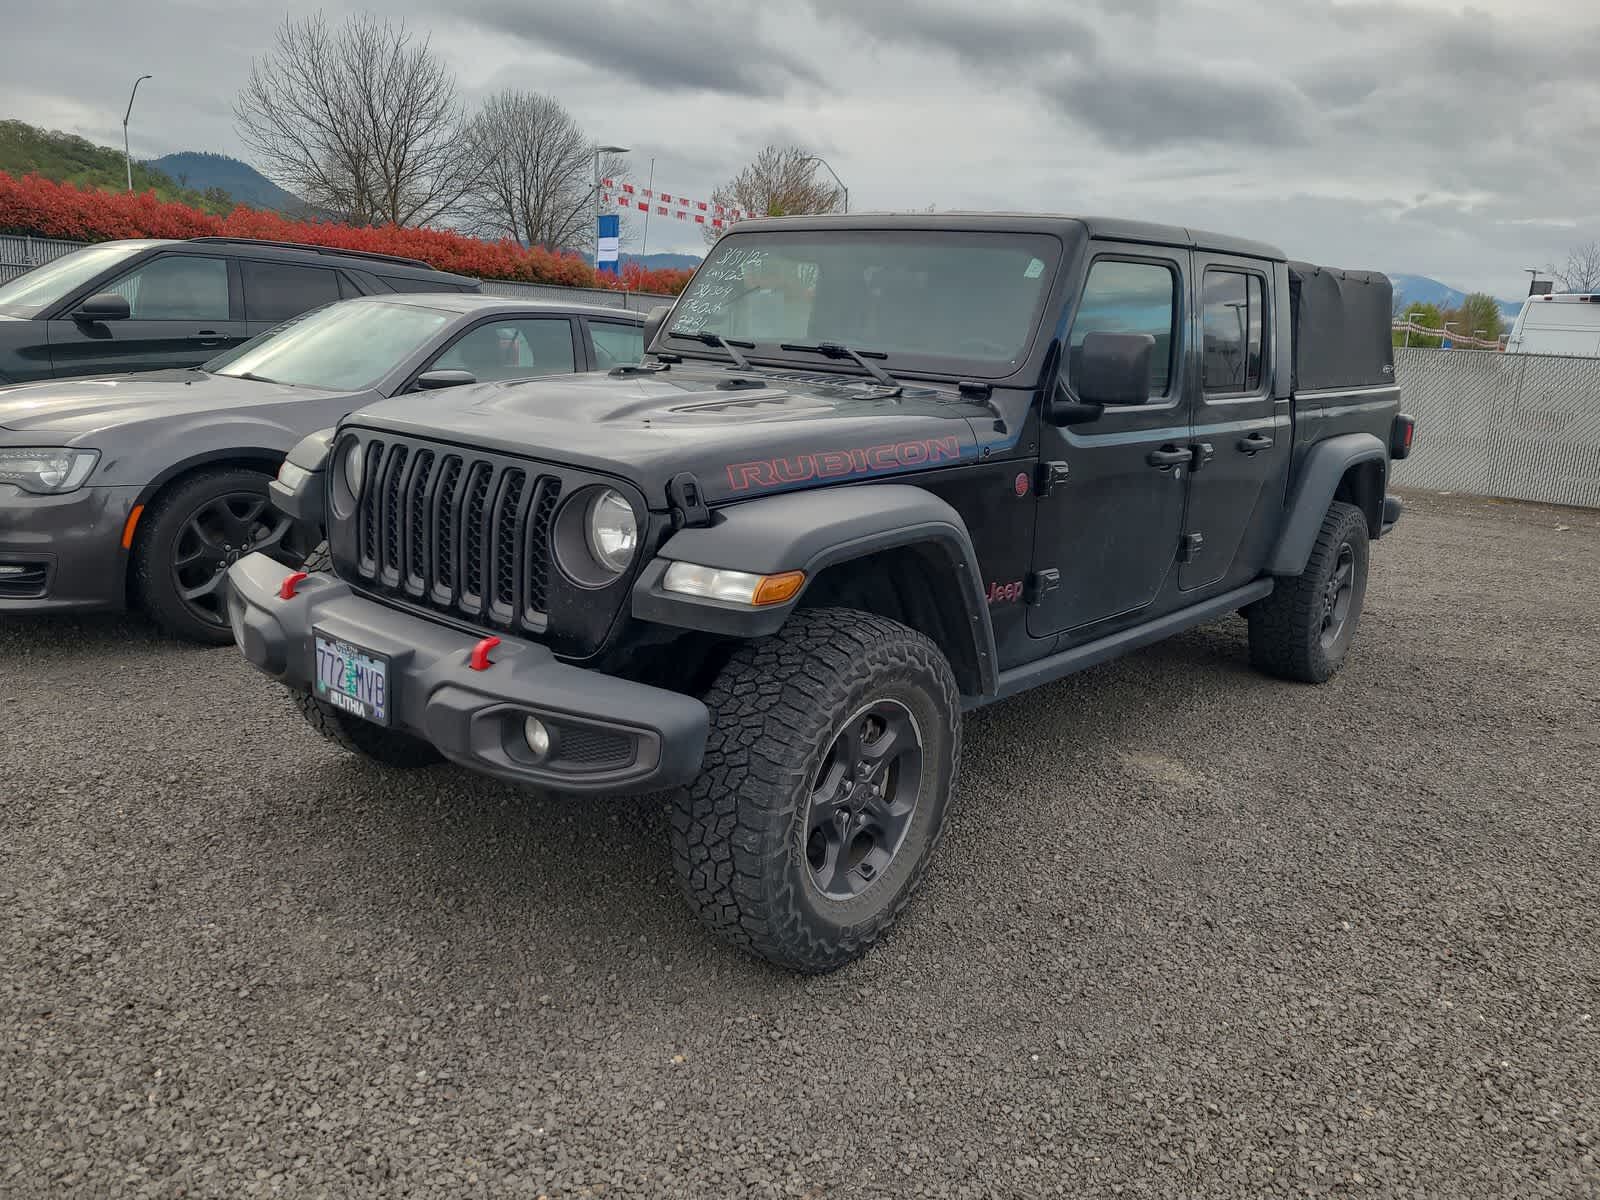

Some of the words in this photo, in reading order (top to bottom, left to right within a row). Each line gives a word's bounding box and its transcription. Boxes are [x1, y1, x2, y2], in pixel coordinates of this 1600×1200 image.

[726, 436, 960, 490] RUBICON
[985, 580, 1023, 603] Jeep
[318, 647, 345, 690] 772
[355, 663, 385, 707] MVB
